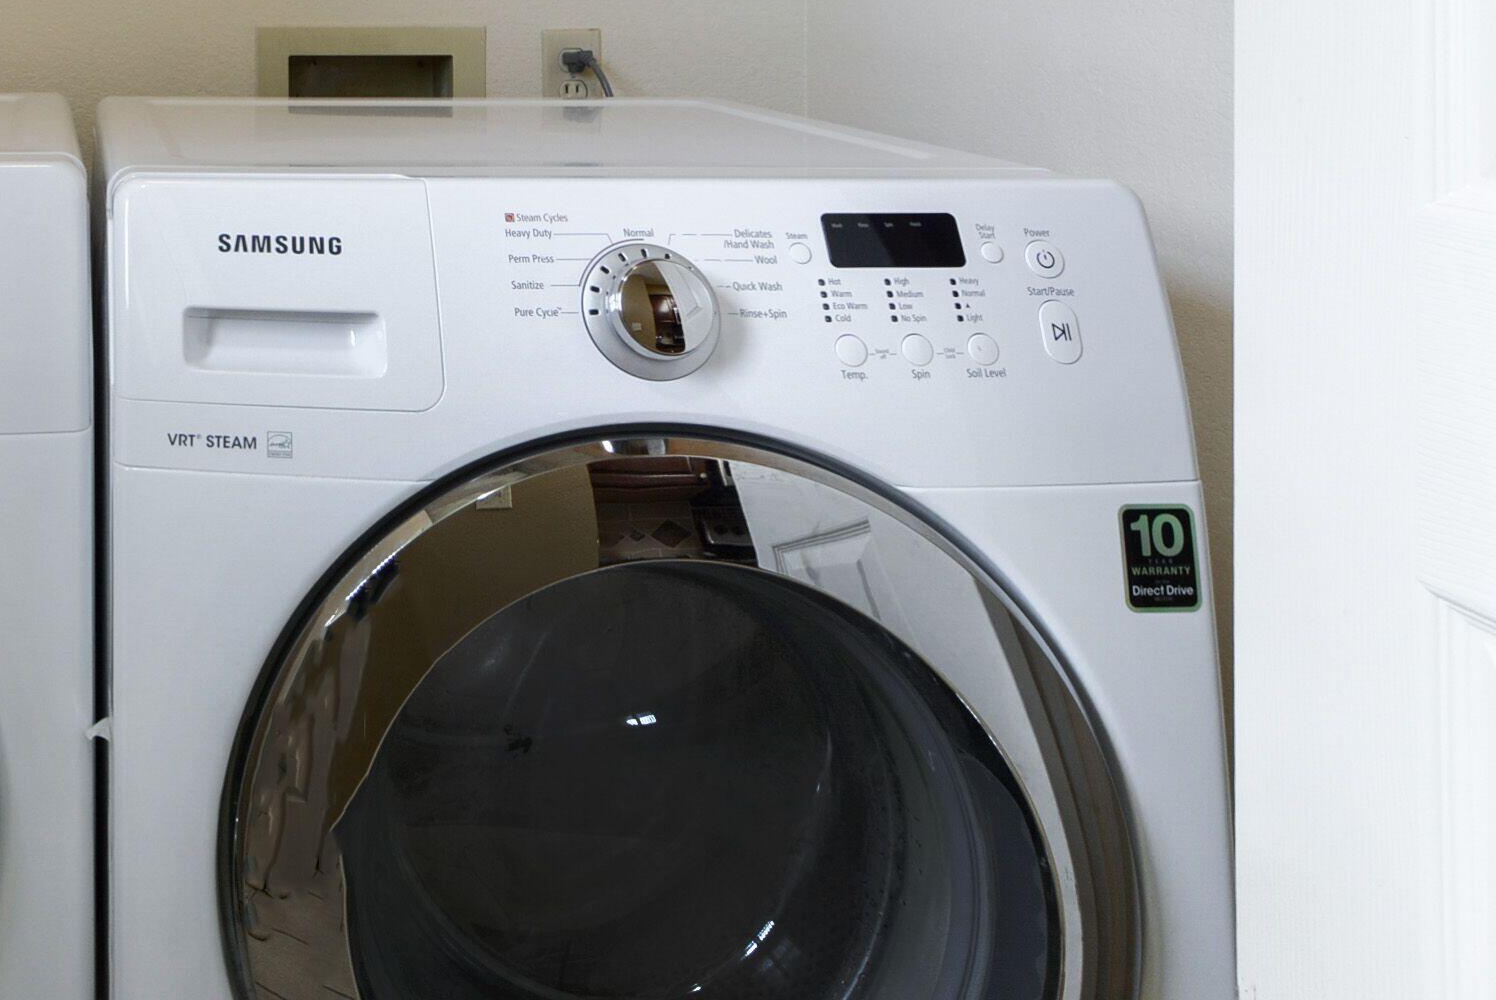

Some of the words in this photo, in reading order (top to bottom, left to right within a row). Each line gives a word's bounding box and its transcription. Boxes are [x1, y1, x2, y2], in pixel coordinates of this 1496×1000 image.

[516, 213, 541, 222] Steam
[543, 213, 568, 224] Cycles
[623, 228, 654, 238] Normal
[975, 224, 995, 233] Delay
[1023, 228, 1050, 237] Power
[505, 229, 532, 240] Heavy
[533, 229, 552, 240] Duty
[734, 229, 772, 239] Delicates
[785, 232, 808, 240] Steam
[218, 234, 342, 255] SAMSUNG
[750, 239, 774, 249] Wash
[508, 254, 532, 263] Perm
[534, 254, 554, 263] Press
[755, 255, 777, 264] Wool
[511, 280, 544, 290] Sanitize
[828, 277, 841, 285] Hot
[894, 277, 909, 287] High
[959, 277, 979, 287] Heavy
[732, 281, 758, 292] Quick
[760, 281, 783, 291] Wash
[831, 290, 852, 298] Warm
[896, 290, 924, 298] Medium
[961, 289, 986, 297] Normal
[1027, 287, 1075, 298] Start/Pause
[833, 302, 845, 310] Eco
[846, 302, 868, 310] Warm
[899, 302, 913, 310] Low
[514, 308, 534, 317] Pure
[739, 309, 787, 321] Rinse+Spin
[835, 314, 852, 322] Cold
[901, 314, 909, 322] No
[910, 314, 927, 324] Spin
[966, 314, 983, 323] Light
[841, 370, 868, 381] Temp.
[912, 369, 931, 380] Spin
[966, 368, 983, 378] Soil
[985, 368, 1007, 378] Level
[206, 435, 257, 450] STEAM
[1130, 513, 1184, 557] 10
[1131, 566, 1191, 576] WARRANTY
[1132, 585, 1164, 596] Direct
[1166, 585, 1194, 596] Drive
